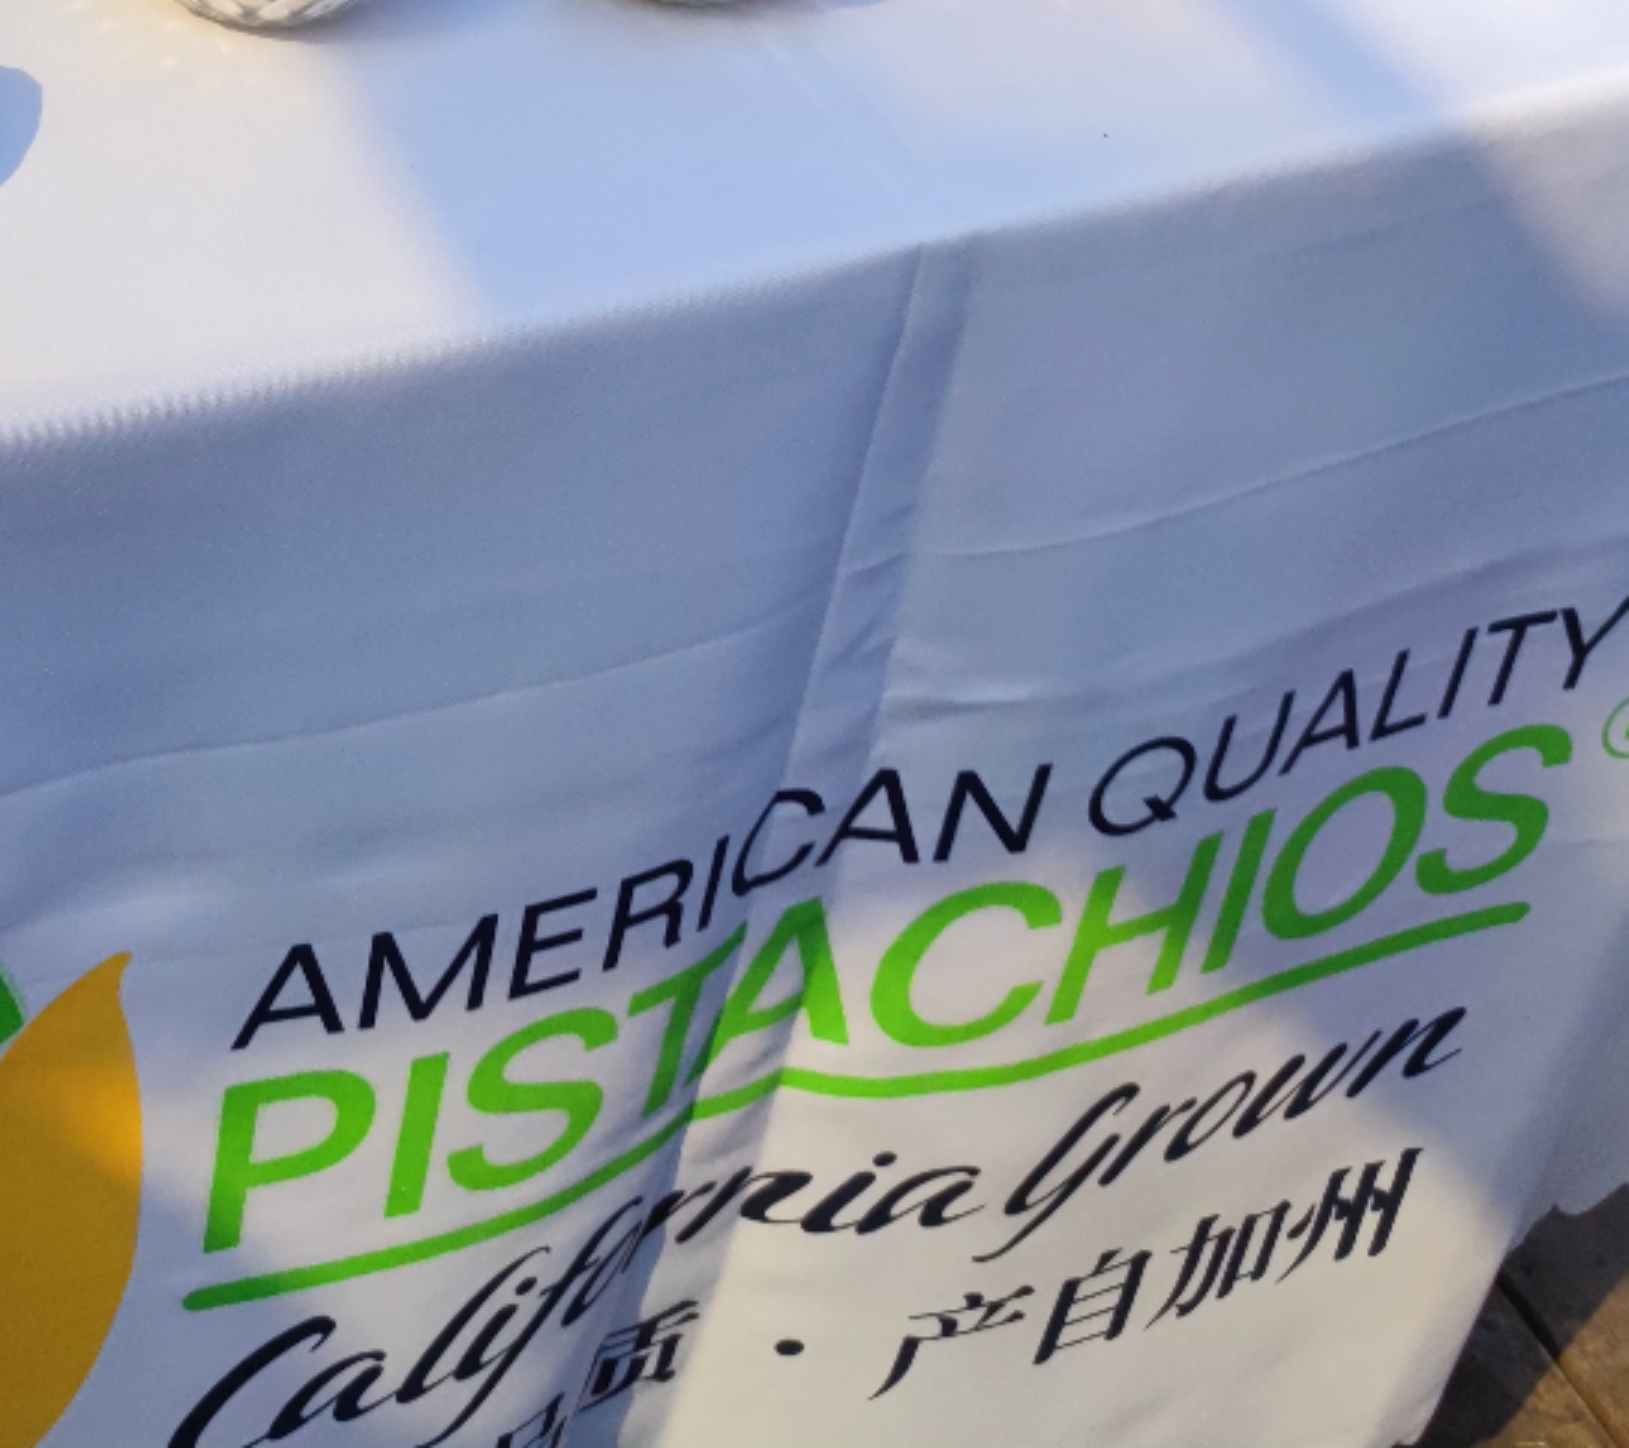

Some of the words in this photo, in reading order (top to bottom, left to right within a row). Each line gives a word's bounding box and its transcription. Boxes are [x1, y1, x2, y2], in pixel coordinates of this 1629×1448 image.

[232, 762, 1053, 1050] AMERICAN
[1085, 594, 1629, 837] QUALITY
[167, 1152, 988, 1448] California
[972, 1006, 1467, 1264] Grown
